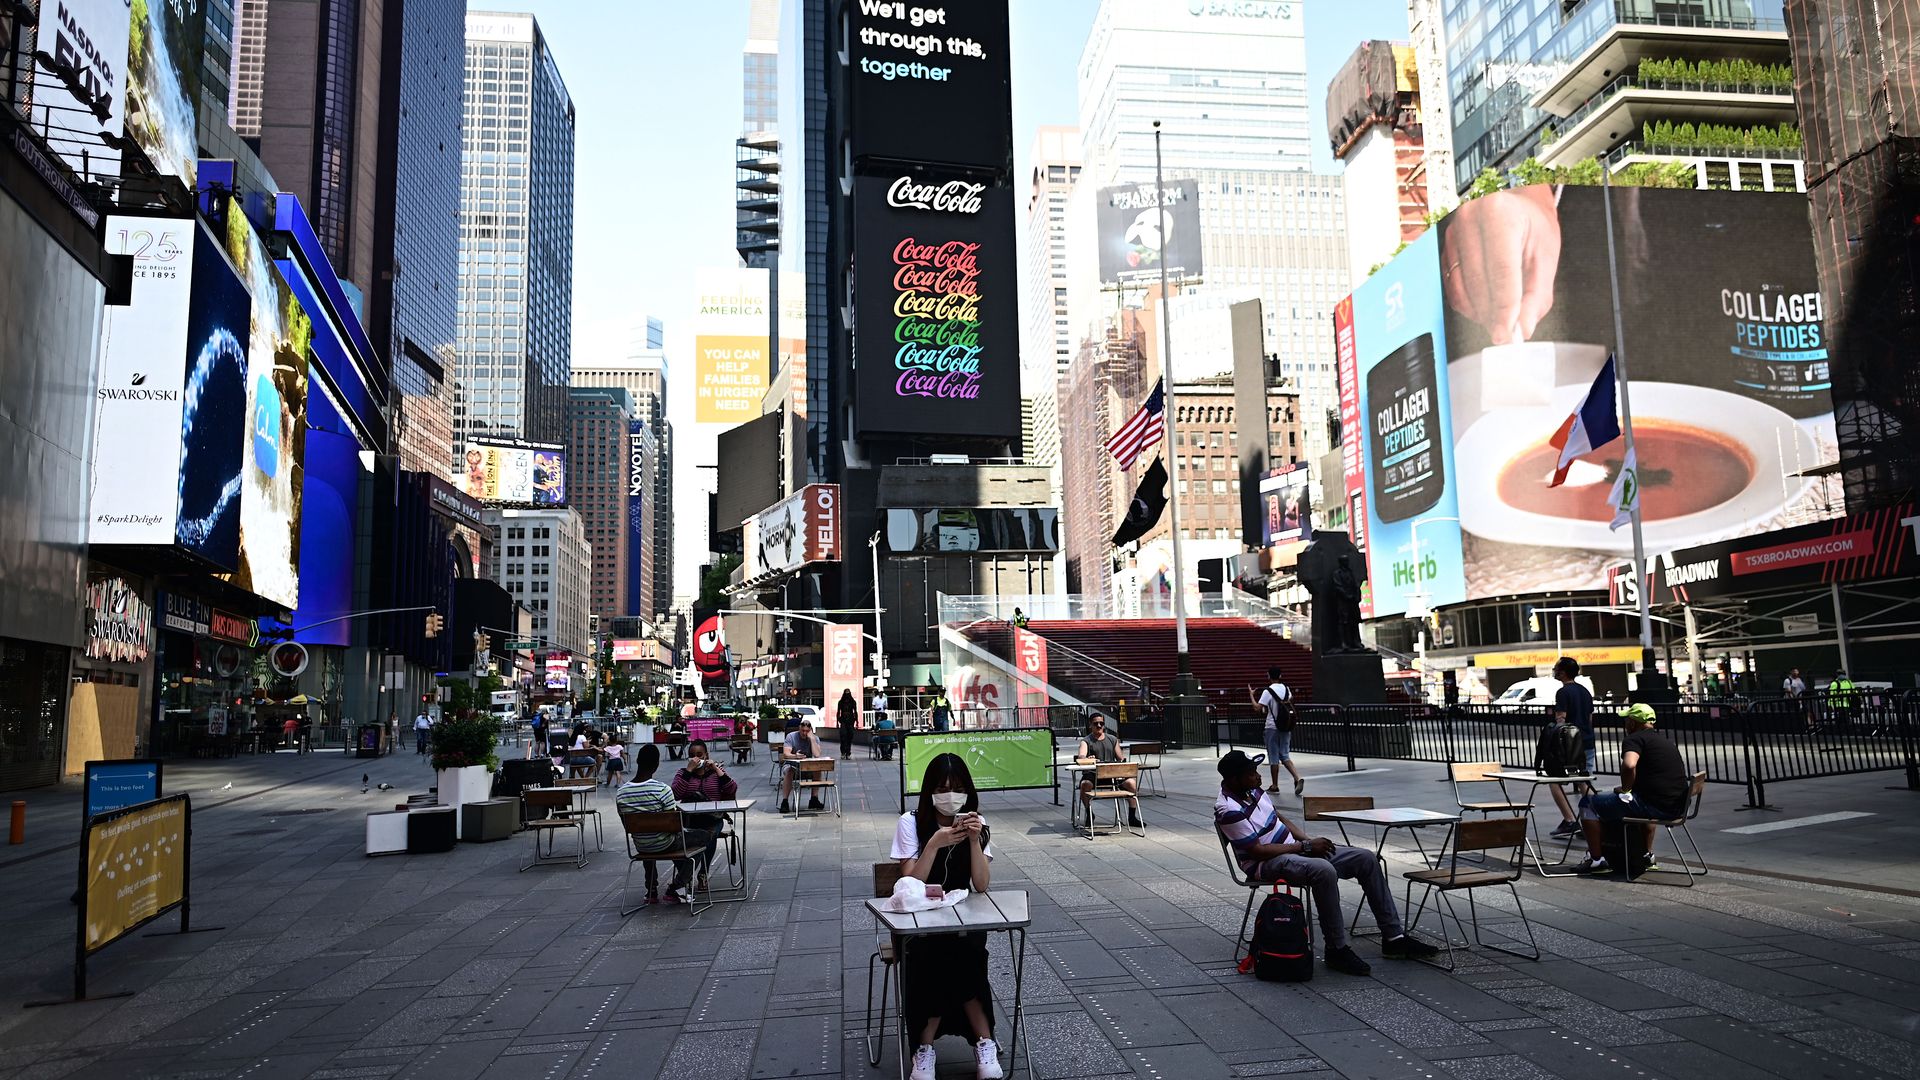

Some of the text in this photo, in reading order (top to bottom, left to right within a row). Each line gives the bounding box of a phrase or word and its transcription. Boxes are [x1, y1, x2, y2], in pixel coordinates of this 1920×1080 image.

[858, 0, 946, 27] We'll get
[859, 27, 987, 60] through this,
[860, 57, 952, 81] together
[19, 136, 70, 197] OUTFRONT
[887, 176, 986, 214] Coca-Cola
[117, 229, 177, 262] 125
[892, 237, 981, 270] Coca-Cola
[152, 271, 176, 279] 1895
[893, 263, 982, 296] Coca-Cola
[700, 306, 763, 315] AMERICA
[701, 295, 763, 305] FEEDING
[893, 290, 983, 321] Coca-Cola
[894, 315, 983, 347] Coca-Cola
[1736, 322, 1820, 349] PEPTIDES
[704, 349, 760, 360] YOU CAN
[715, 361, 749, 372] HELP
[894, 342, 984, 373] Coca-Cola
[699, 386, 766, 398] IN URGENT
[704, 374, 760, 385] FAMILIES
[895, 368, 985, 399] Coca-Cola
[98, 388, 178, 401] SWAROVSKI
[715, 400, 750, 410] NEED
[1338, 323, 1358, 479] HERSHEY'S STORE
[1377, 387, 1430, 436] COLLAGEN
[256, 404, 278, 450] Calm
[1384, 418, 1425, 456] PEPTIDES
[485, 449, 497, 497] THE LION KING
[512, 451, 528, 498] FROZEN
[629, 427, 643, 497] NOVOTEL
[1270, 463, 1297, 478] APOLLO
[97, 514, 163, 527] #SparkDelight
[817, 488, 834, 558] HELLO!
[765, 523, 796, 551] MORMON
[1745, 539, 1853, 567] TSXBROADWAY.COM
[1392, 553, 1437, 588] iHerb
[1664, 559, 1719, 588] BROADWAY
[167, 592, 193, 618] BLUE
[90, 620, 142, 645] SWAROVSKI
[166, 614, 190, 631] SEAFOOD
[981, 735, 1006, 743] yourself
[522, 782, 541, 790] TIMES
